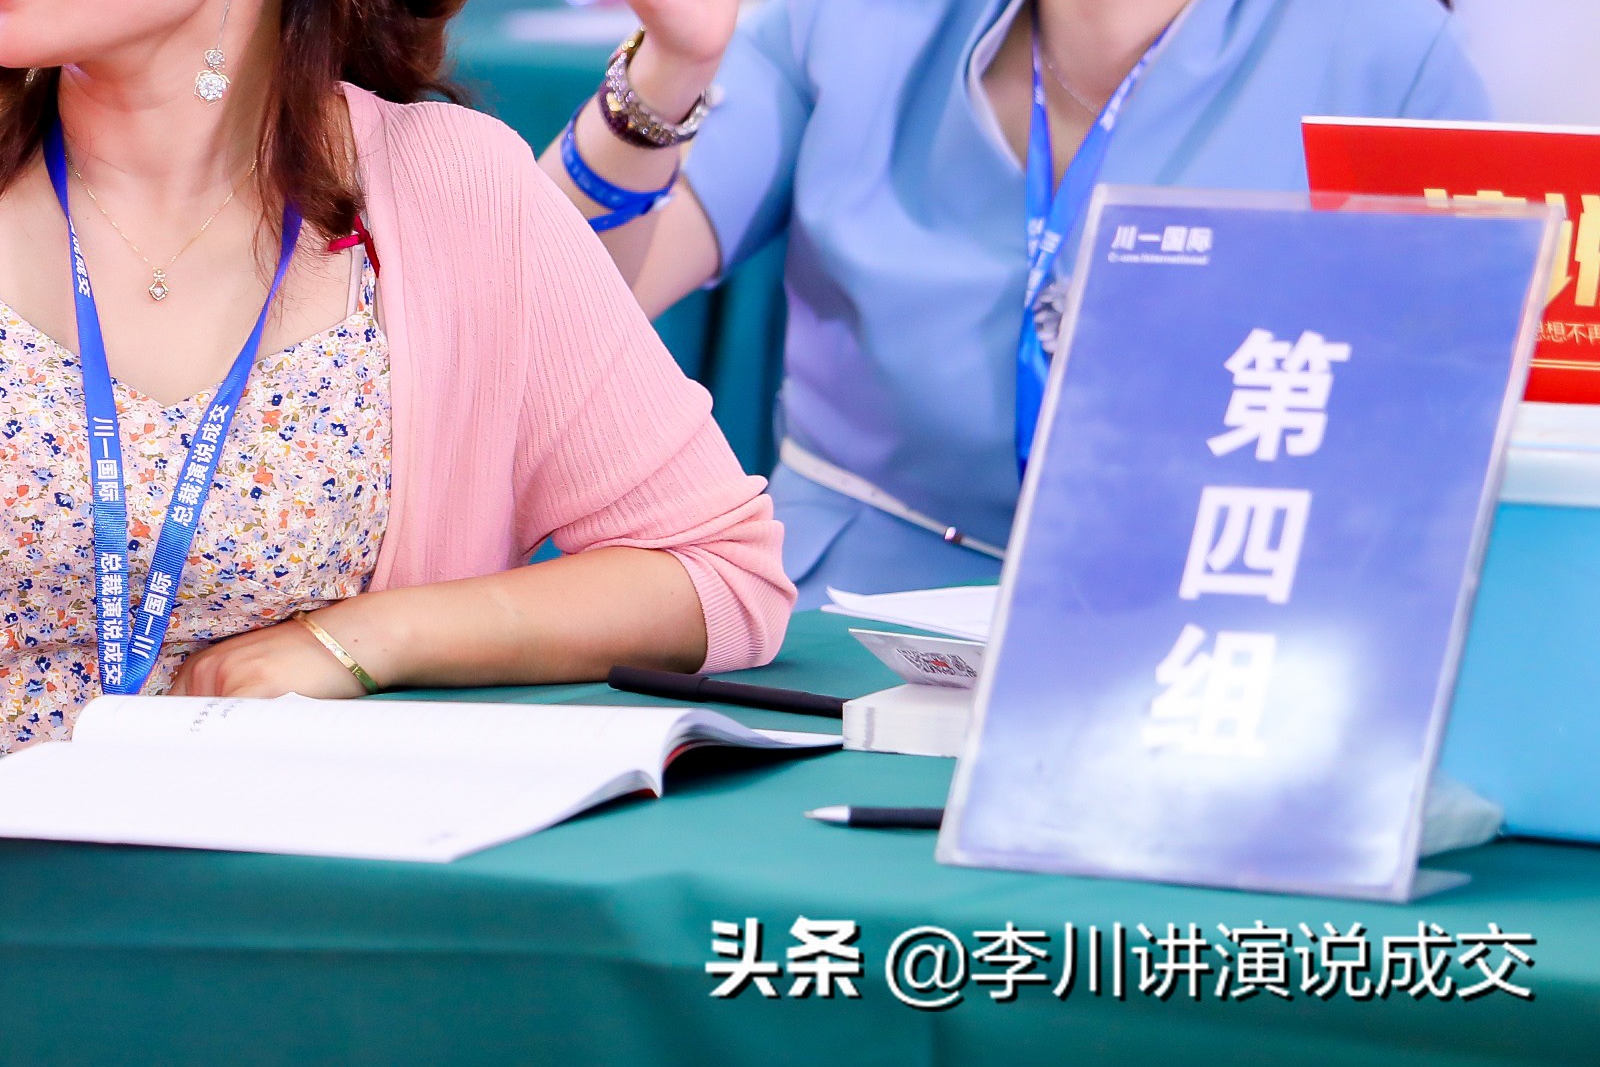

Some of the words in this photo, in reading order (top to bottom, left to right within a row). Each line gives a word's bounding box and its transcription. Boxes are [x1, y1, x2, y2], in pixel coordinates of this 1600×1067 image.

[92, 416, 120, 503] 川一国际
[131, 571, 173, 660] 川一国际
[171, 403, 230, 527] 总裁演说成交
[1140, 329, 1351, 759] 第四组
[100, 551, 123, 686] 总裁演说成交
